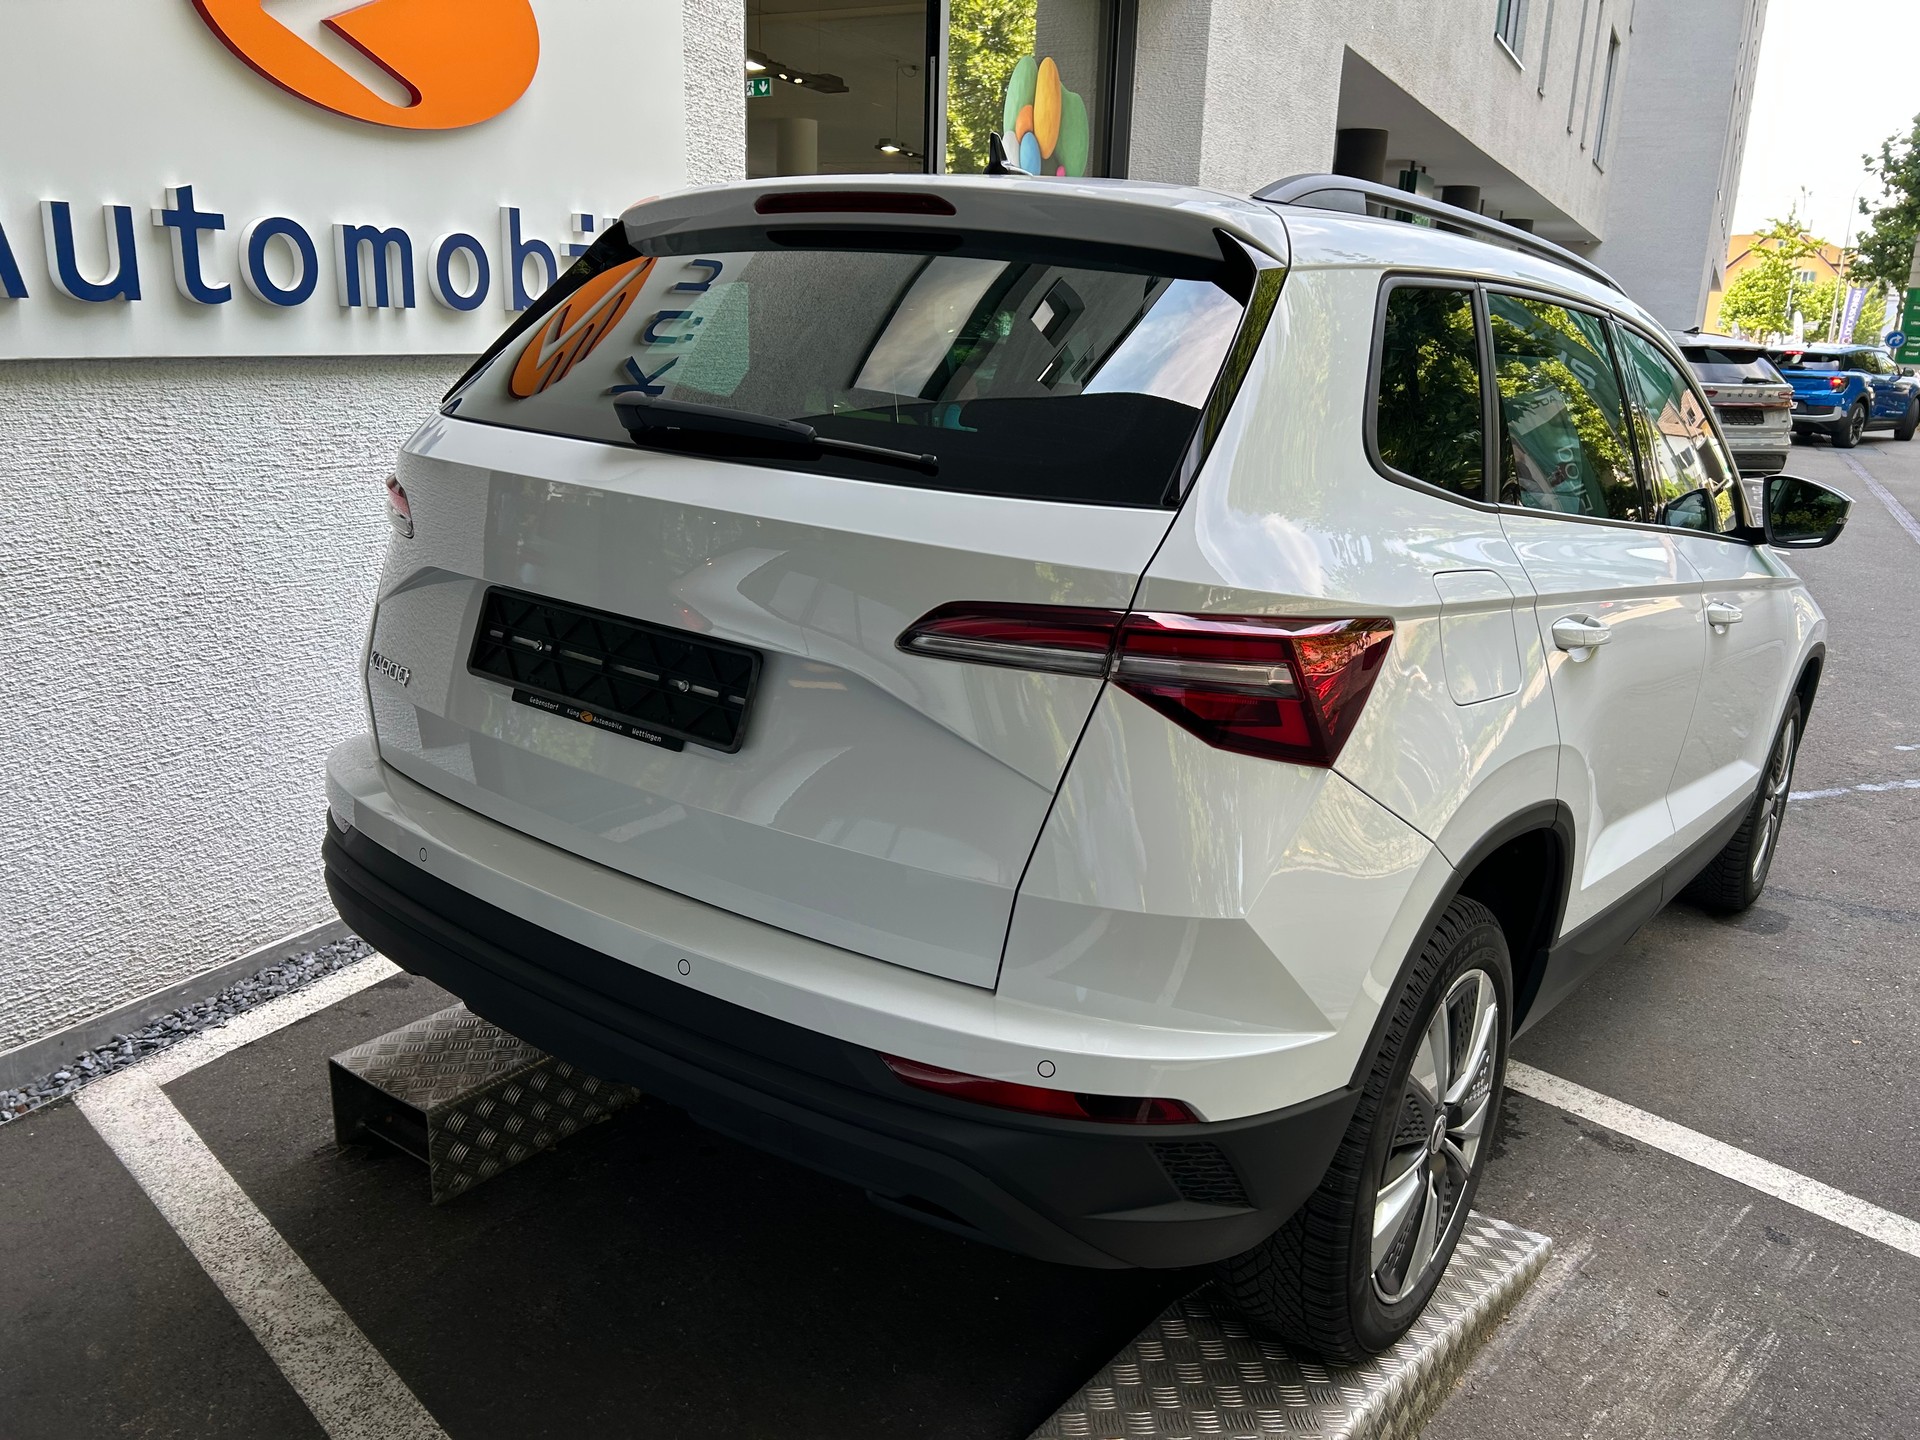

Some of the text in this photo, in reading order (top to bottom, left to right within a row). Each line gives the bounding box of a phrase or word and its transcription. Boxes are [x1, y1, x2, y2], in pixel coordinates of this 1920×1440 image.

[370, 651, 411, 687] KAROQ
[529, 696, 662, 743] Gebenstorf Küng Automobile Wettingen
